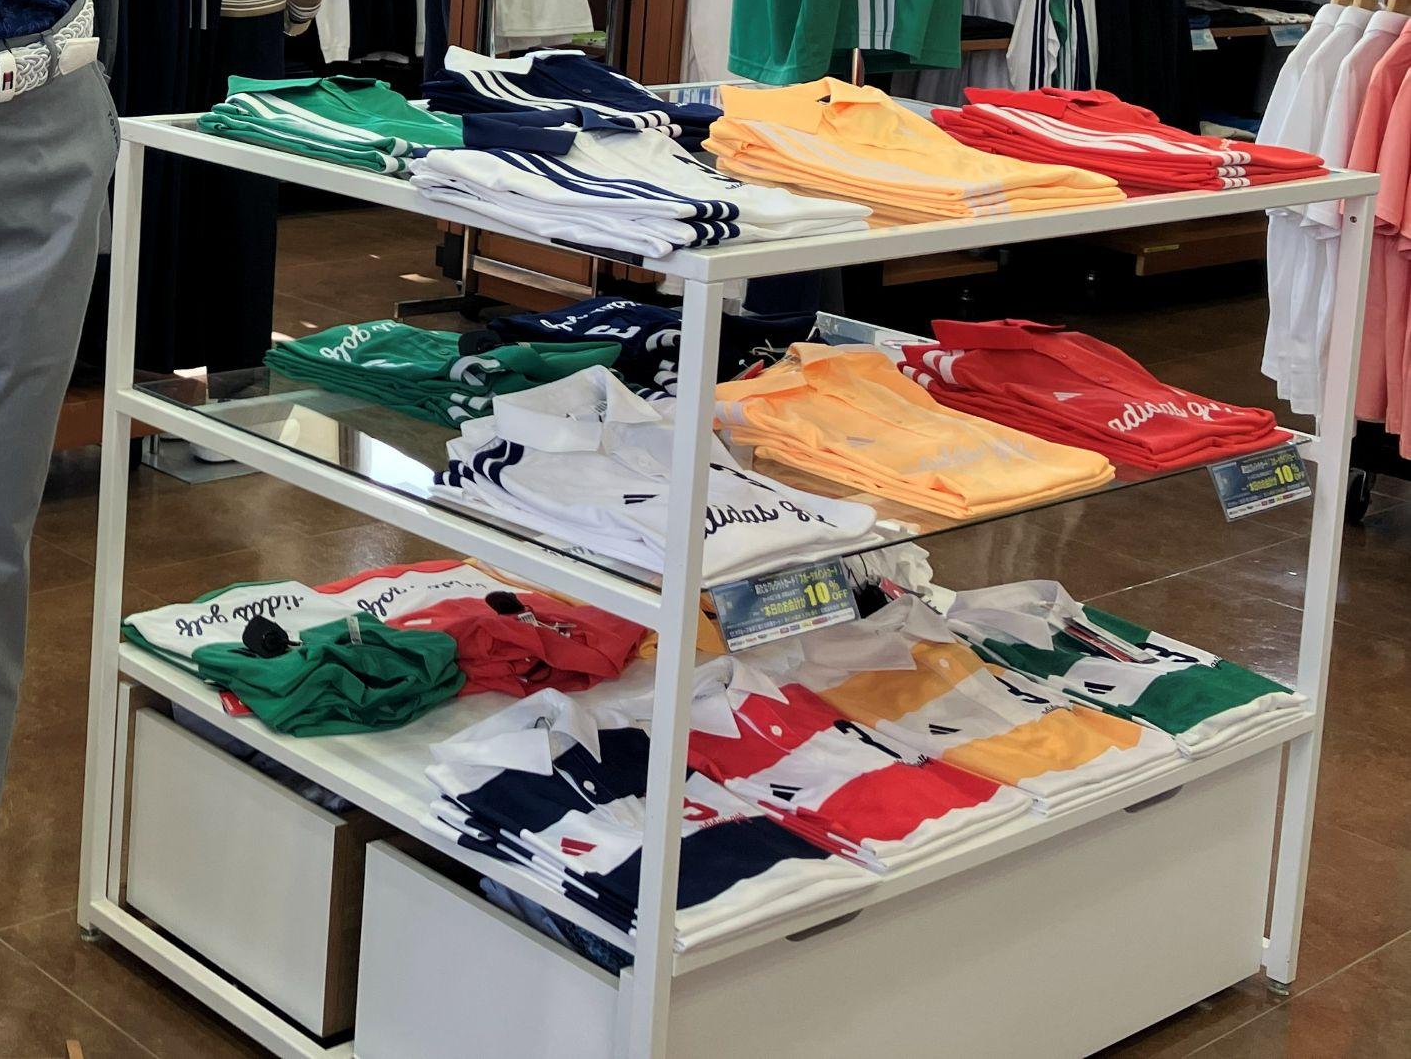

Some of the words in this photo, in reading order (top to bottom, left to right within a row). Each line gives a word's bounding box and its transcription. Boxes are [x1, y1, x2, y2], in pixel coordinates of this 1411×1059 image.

[1275, 464, 1295, 485] 10
[804, 581, 831, 607] 10
[831, 589, 848, 601] OFF
